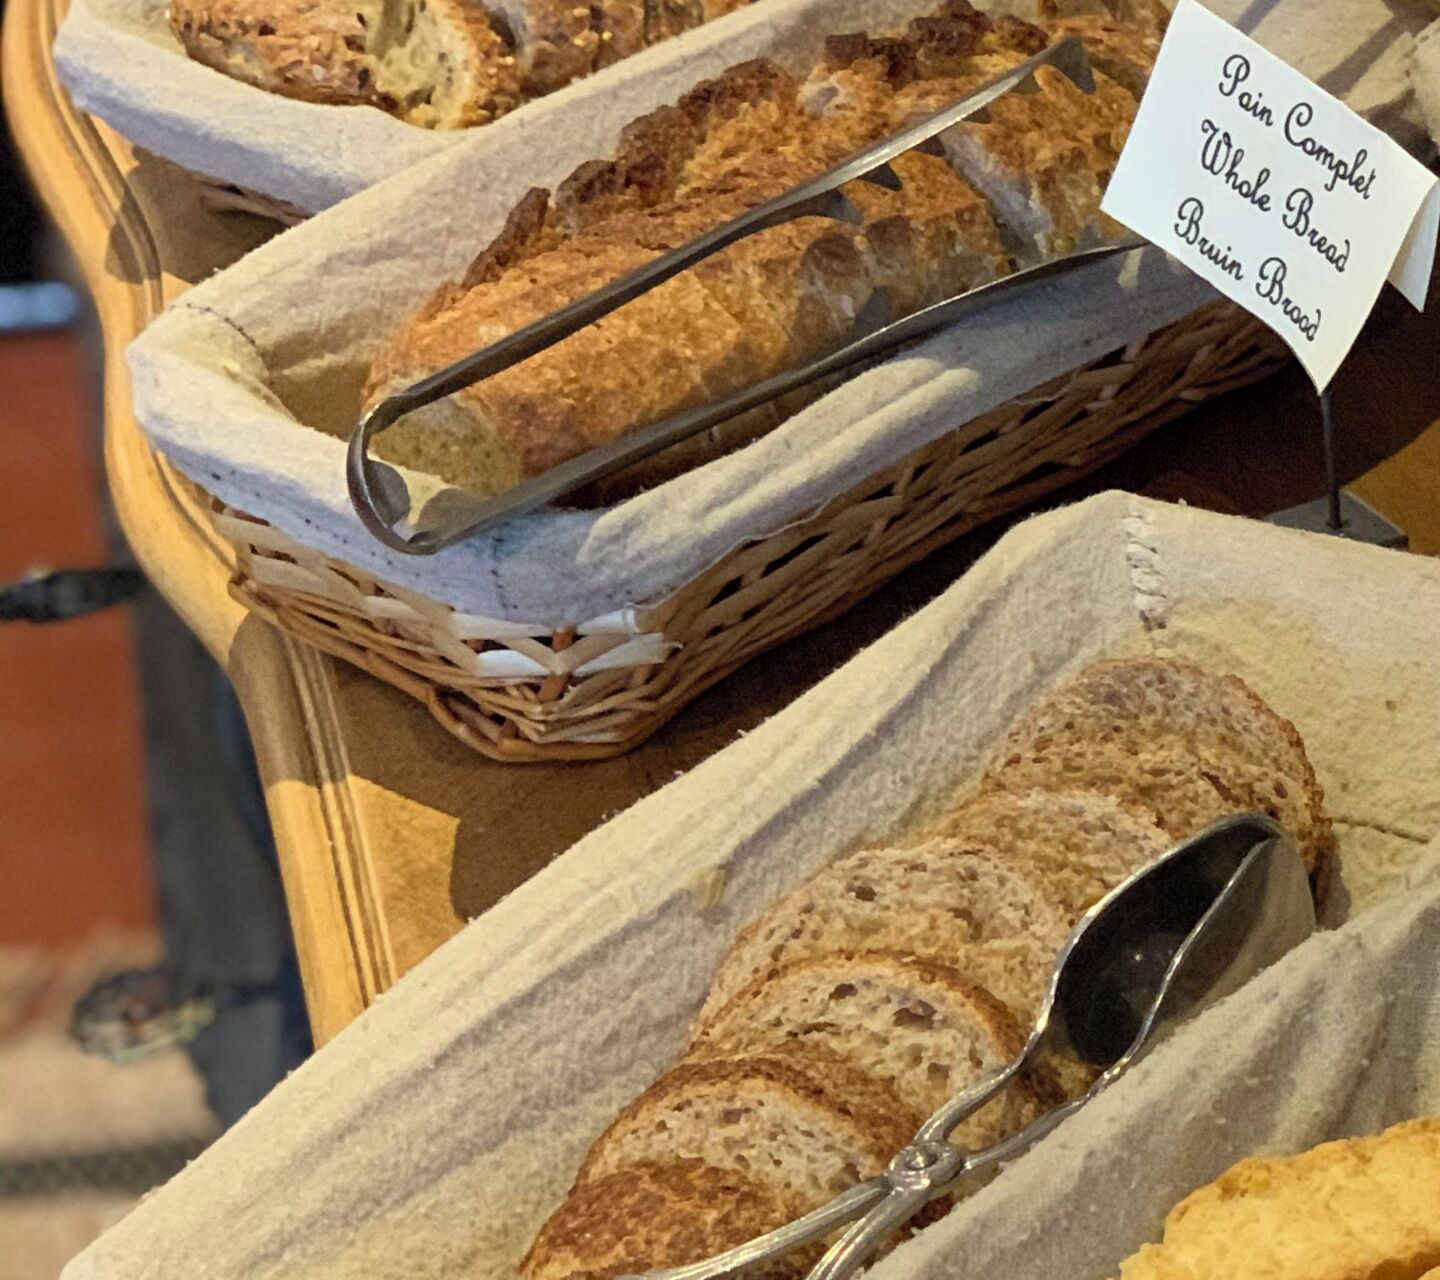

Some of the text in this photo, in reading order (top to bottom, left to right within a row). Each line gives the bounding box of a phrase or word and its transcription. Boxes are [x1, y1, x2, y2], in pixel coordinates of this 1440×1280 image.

[1201, 119, 1351, 272] Whole Bread
[1218, 54, 1376, 200] Pain Complet
[1174, 197, 1321, 341] Bruin Brood
